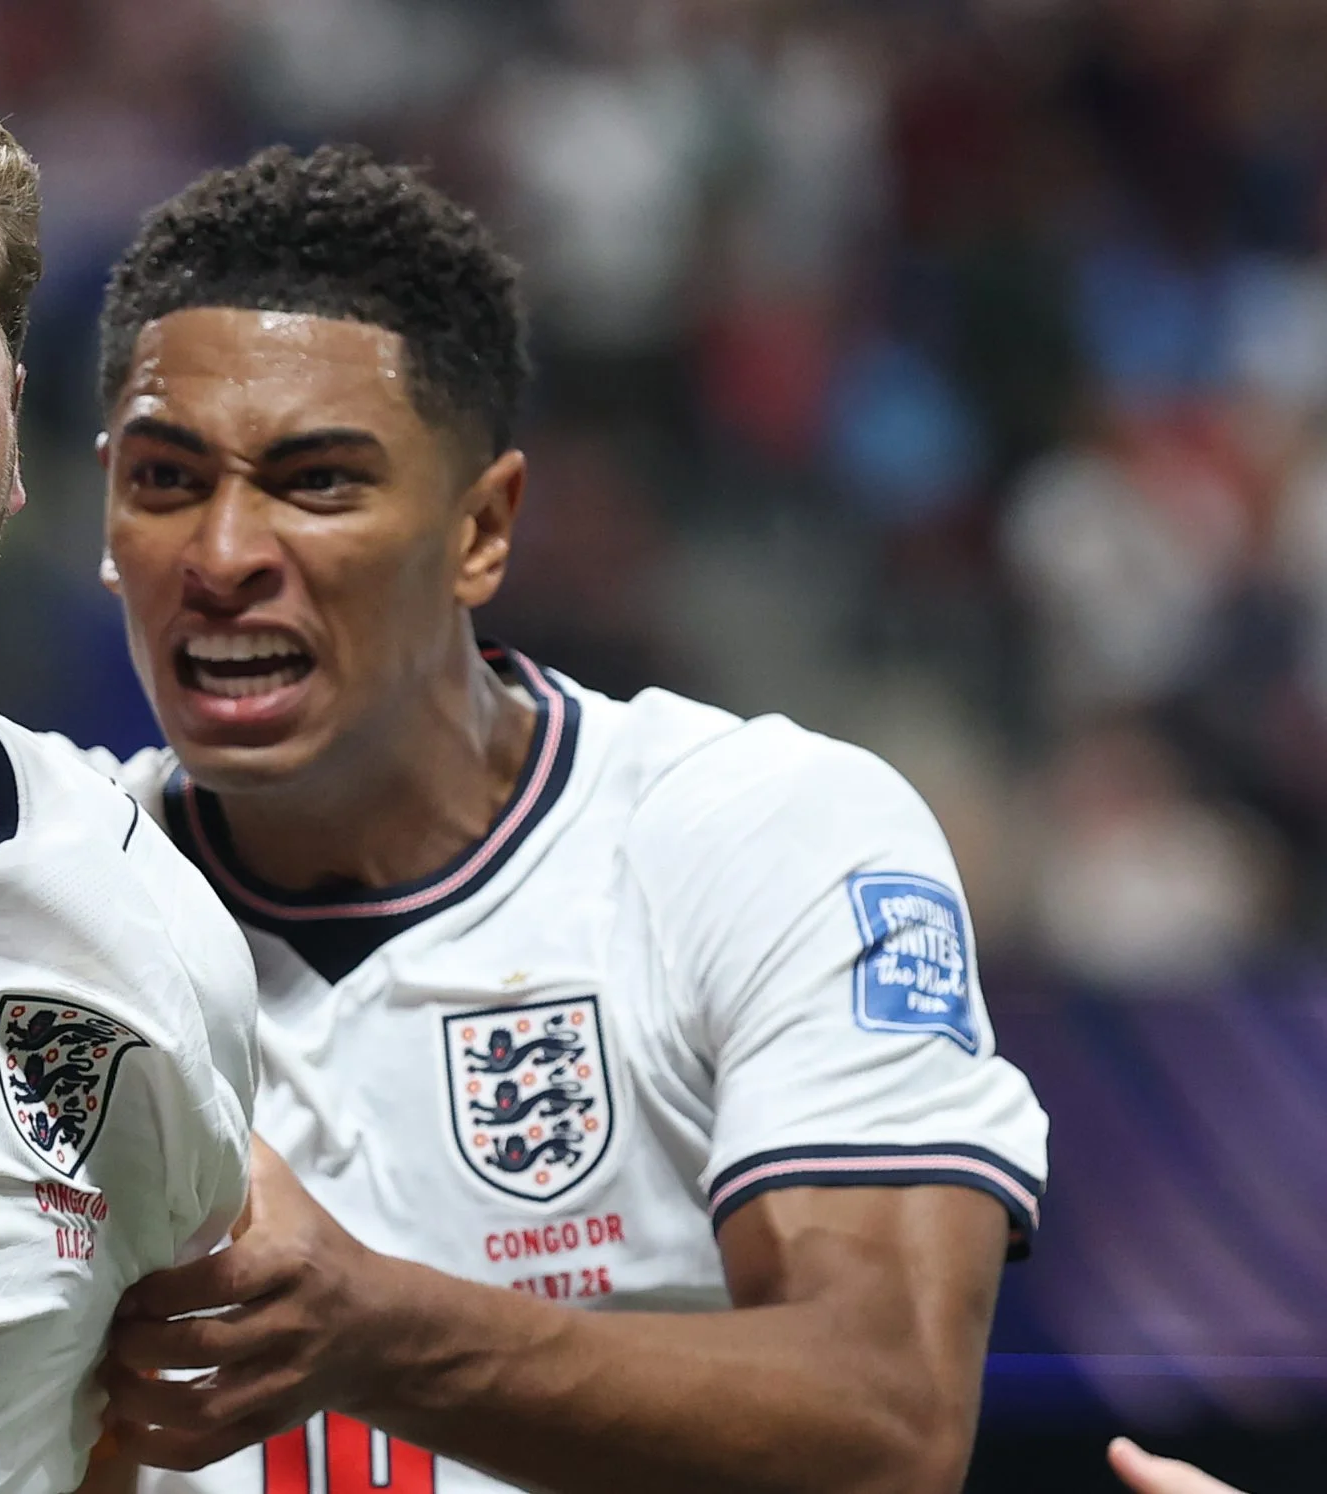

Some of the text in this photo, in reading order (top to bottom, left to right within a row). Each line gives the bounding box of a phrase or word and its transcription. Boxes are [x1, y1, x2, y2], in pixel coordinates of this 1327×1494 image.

[874, 953, 916, 986] the
[34, 1182, 94, 1215] CONGO
[485, 1213, 625, 1262] CONGO DR
